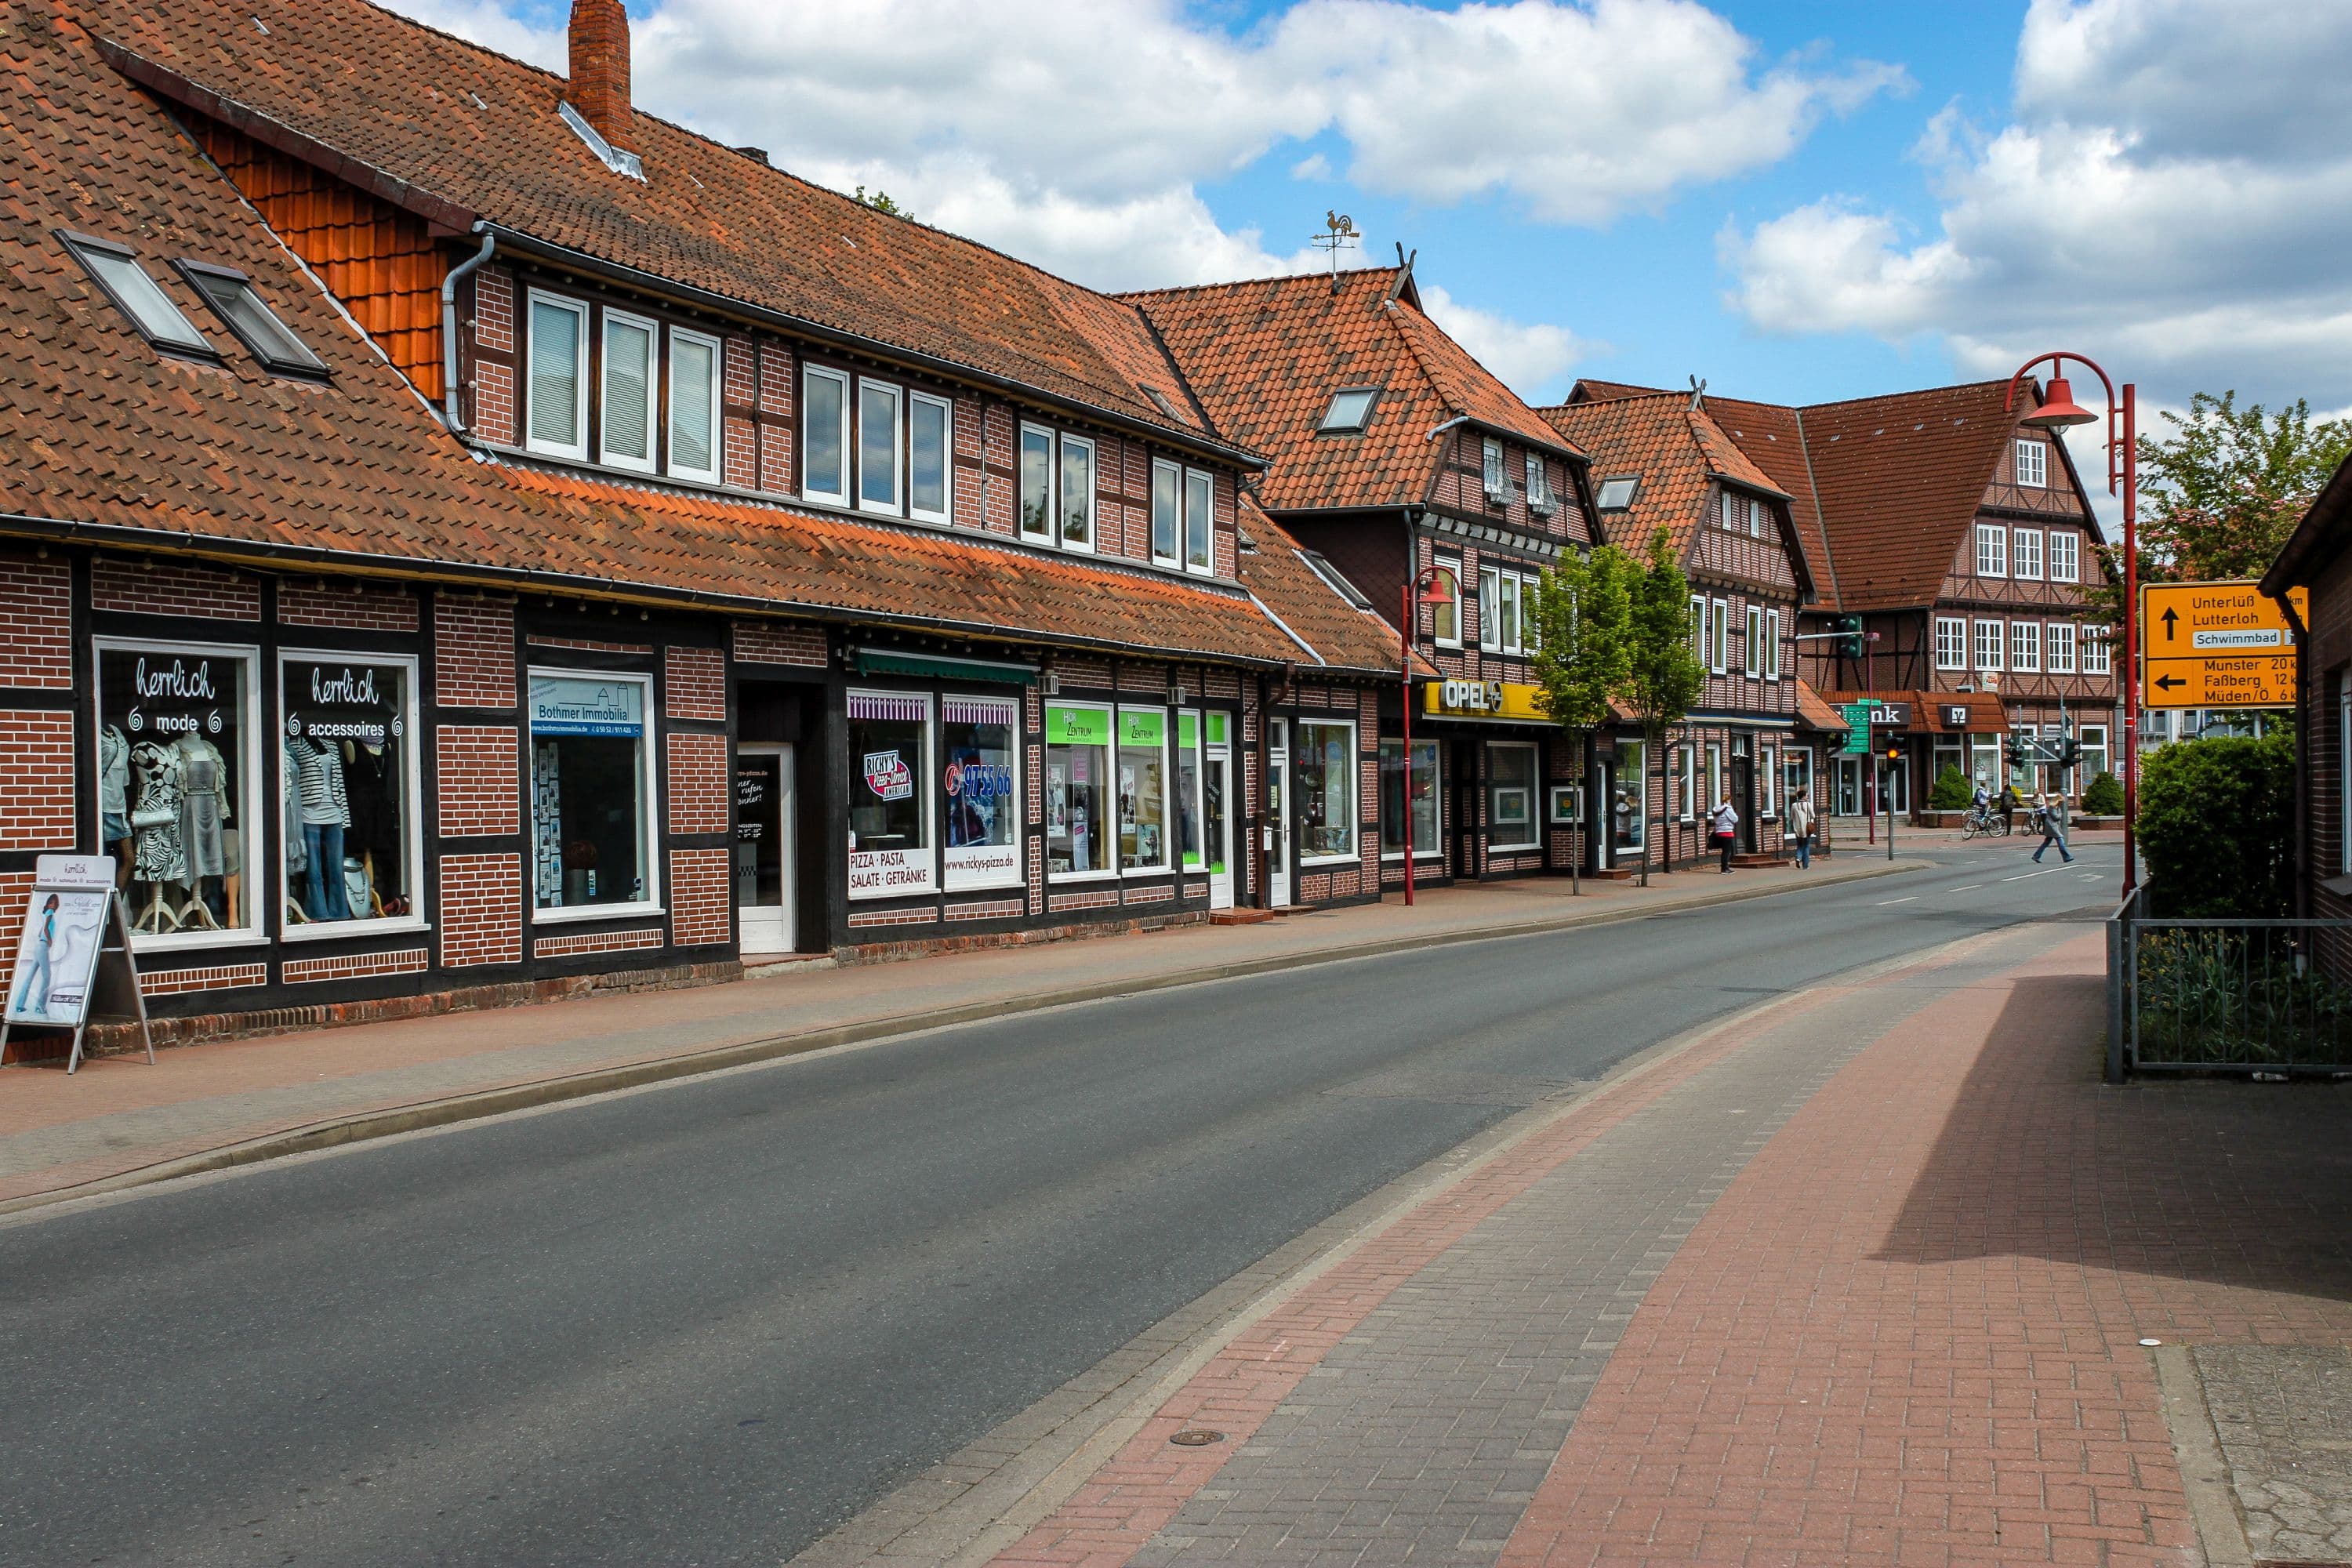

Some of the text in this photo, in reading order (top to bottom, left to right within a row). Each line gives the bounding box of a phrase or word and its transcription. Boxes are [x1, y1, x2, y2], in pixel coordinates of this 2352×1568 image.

[2192, 595, 2254, 609] Unterlüß
[2193, 612, 2259, 626] Lutterloh
[2197, 633, 2278, 644] Schwimmbad
[2205, 659, 2296, 671] Munster 20 k
[136, 657, 215, 699] herrlich
[313, 666, 379, 705] herrlich
[2205, 673, 2296, 688] Faßberg 12 k
[1446, 681, 1490, 710] OPEL
[2280, 690, 2288, 700] 6
[2290, 691, 2296, 700] k
[539, 705, 627, 721] Bothmer Immobilia
[1871, 706, 1900, 723] nk
[157, 714, 198, 731] mode
[309, 721, 384, 736] accessoires
[1066, 722, 1092, 737] ZENTRUM
[1131, 725, 1153, 739] ZENTRUM
[866, 754, 896, 775] RICKY'S
[741, 784, 764, 797] rufen
[885, 784, 909, 797] AMERICAN
[851, 851, 905, 869] PIZZA PASTA
[945, 853, 1014, 873] www.rickys-pizza.de
[851, 866, 927, 888] SALATE GETRÄNKE
